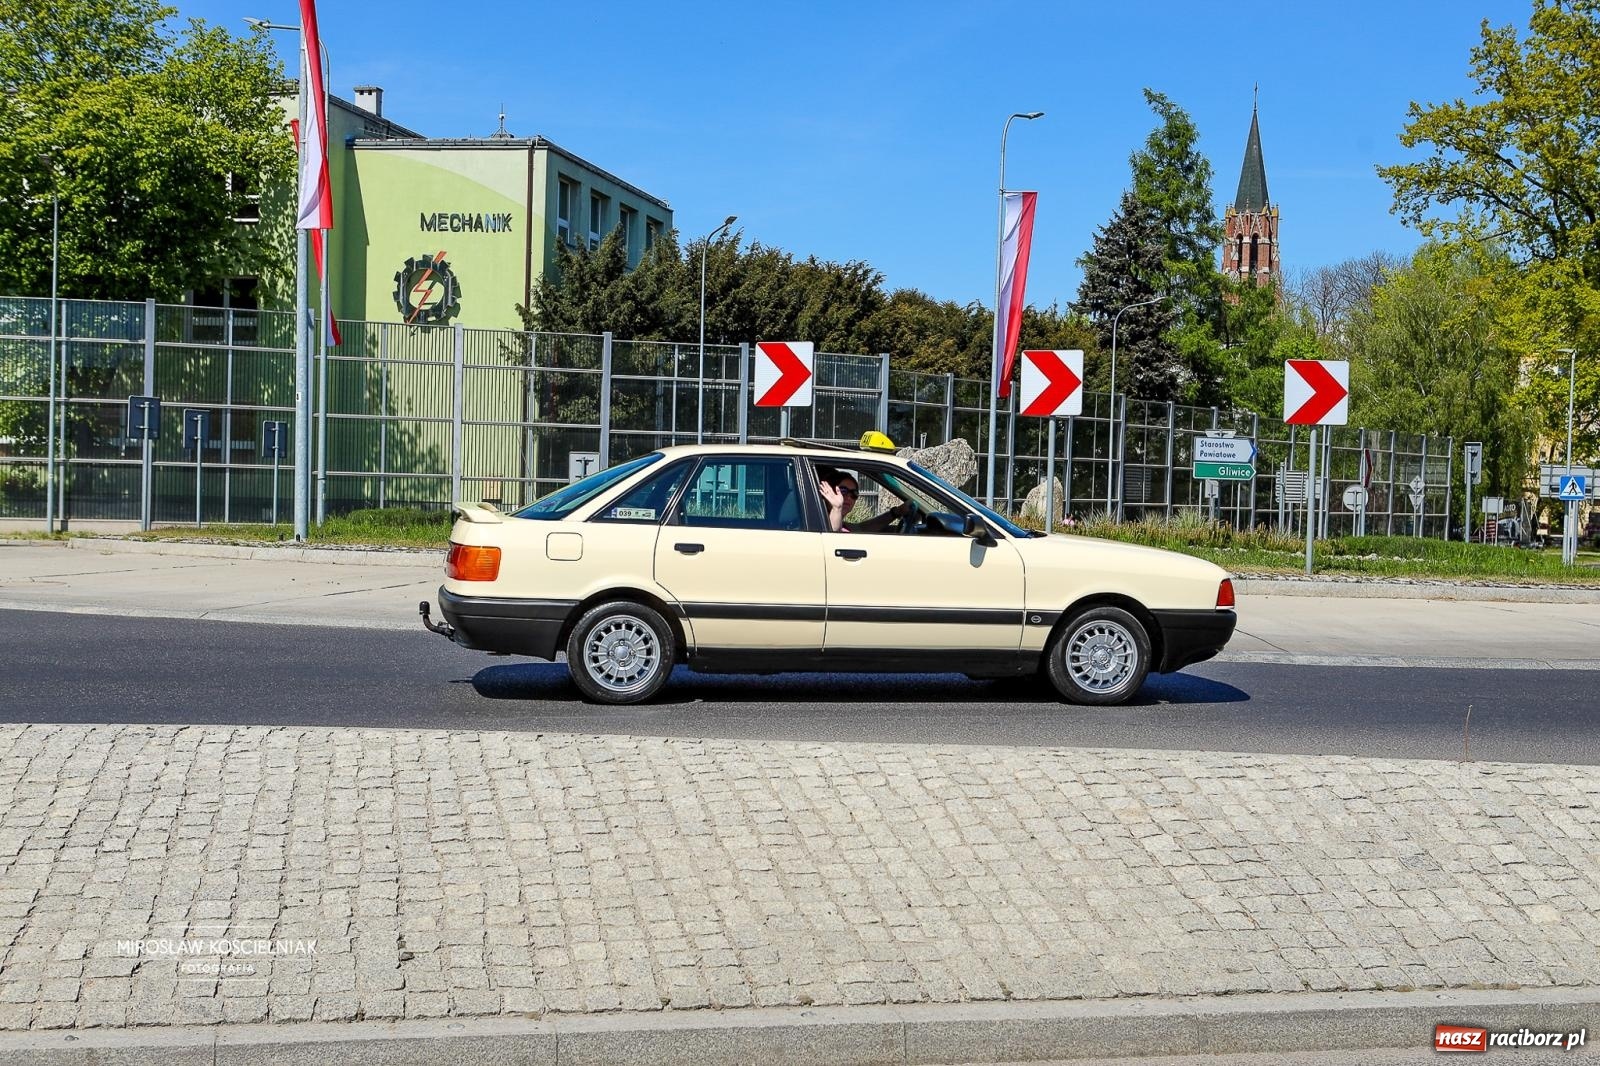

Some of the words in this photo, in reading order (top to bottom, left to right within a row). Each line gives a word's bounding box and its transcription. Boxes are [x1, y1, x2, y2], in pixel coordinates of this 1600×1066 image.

[420, 212, 512, 233] MECHANIK
[1200, 440, 1235, 449] Starostwo
[1199, 450, 1237, 459] Powiatowe
[1218, 466, 1251, 477] Gliwice
